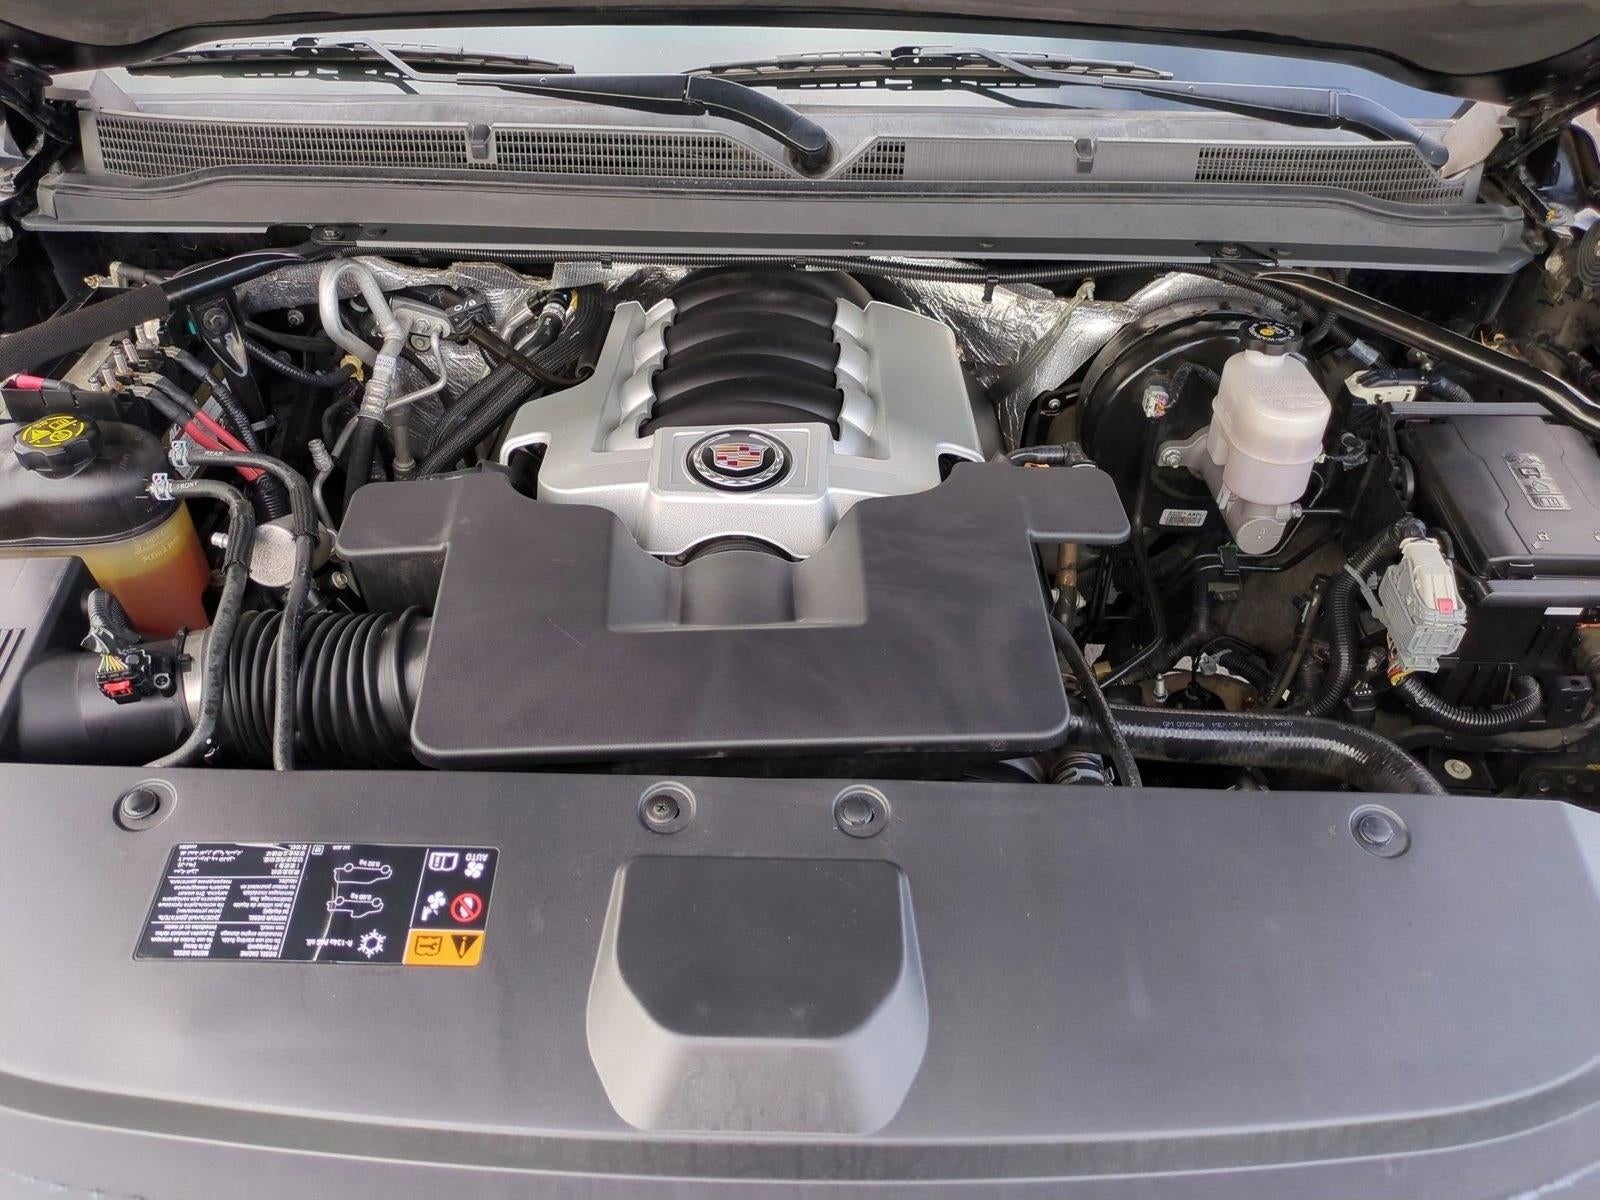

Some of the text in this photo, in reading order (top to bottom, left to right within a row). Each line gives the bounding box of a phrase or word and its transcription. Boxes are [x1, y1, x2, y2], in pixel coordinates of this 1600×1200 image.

[176, 480, 199, 490] FRONT
[465, 853, 488, 862] AUTO
[350, 892, 359, 900] kg
[329, 939, 353, 947] R-134a
